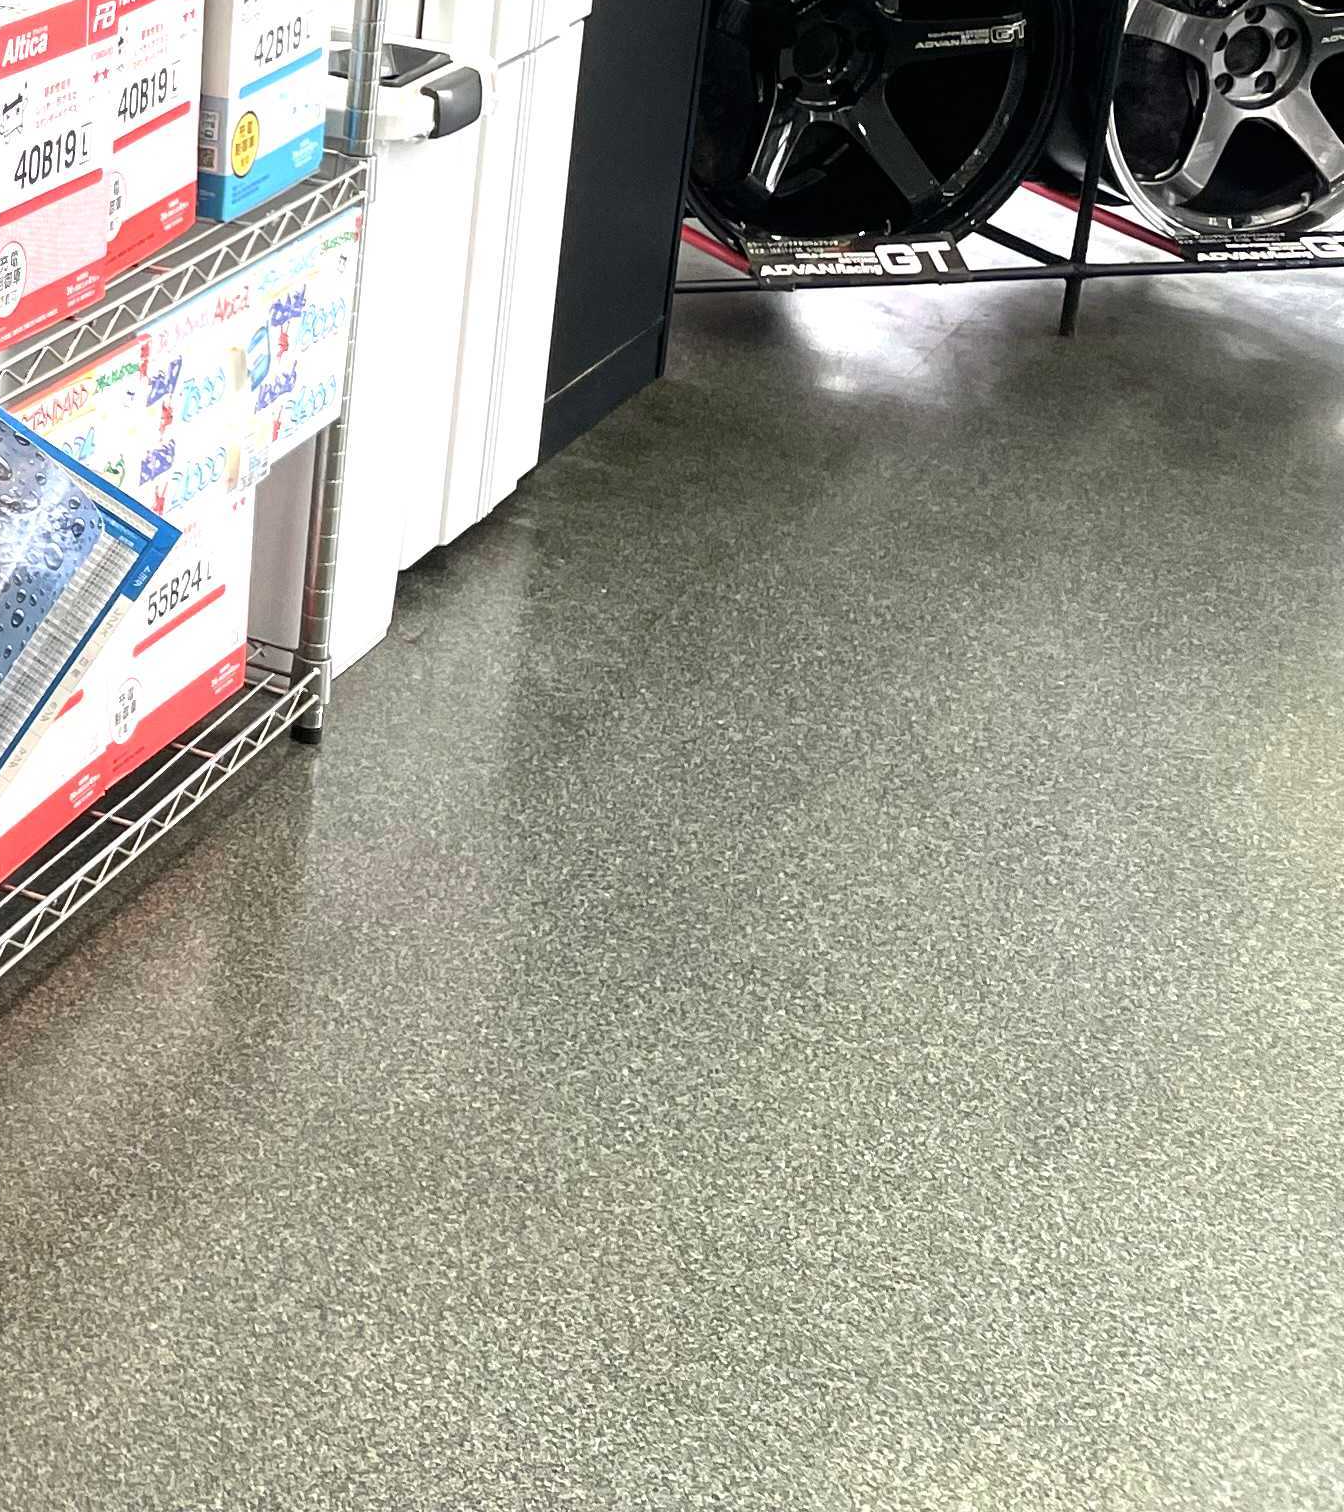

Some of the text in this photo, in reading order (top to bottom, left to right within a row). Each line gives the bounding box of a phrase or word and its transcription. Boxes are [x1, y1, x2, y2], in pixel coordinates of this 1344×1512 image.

[2, 33, 49, 68] Altica
[990, 20, 1027, 44] GT
[118, 68, 168, 123] 40B19
[14, 129, 76, 189] 40B19
[760, 264, 835, 277] ADVAN
[874, 240, 952, 275] GT
